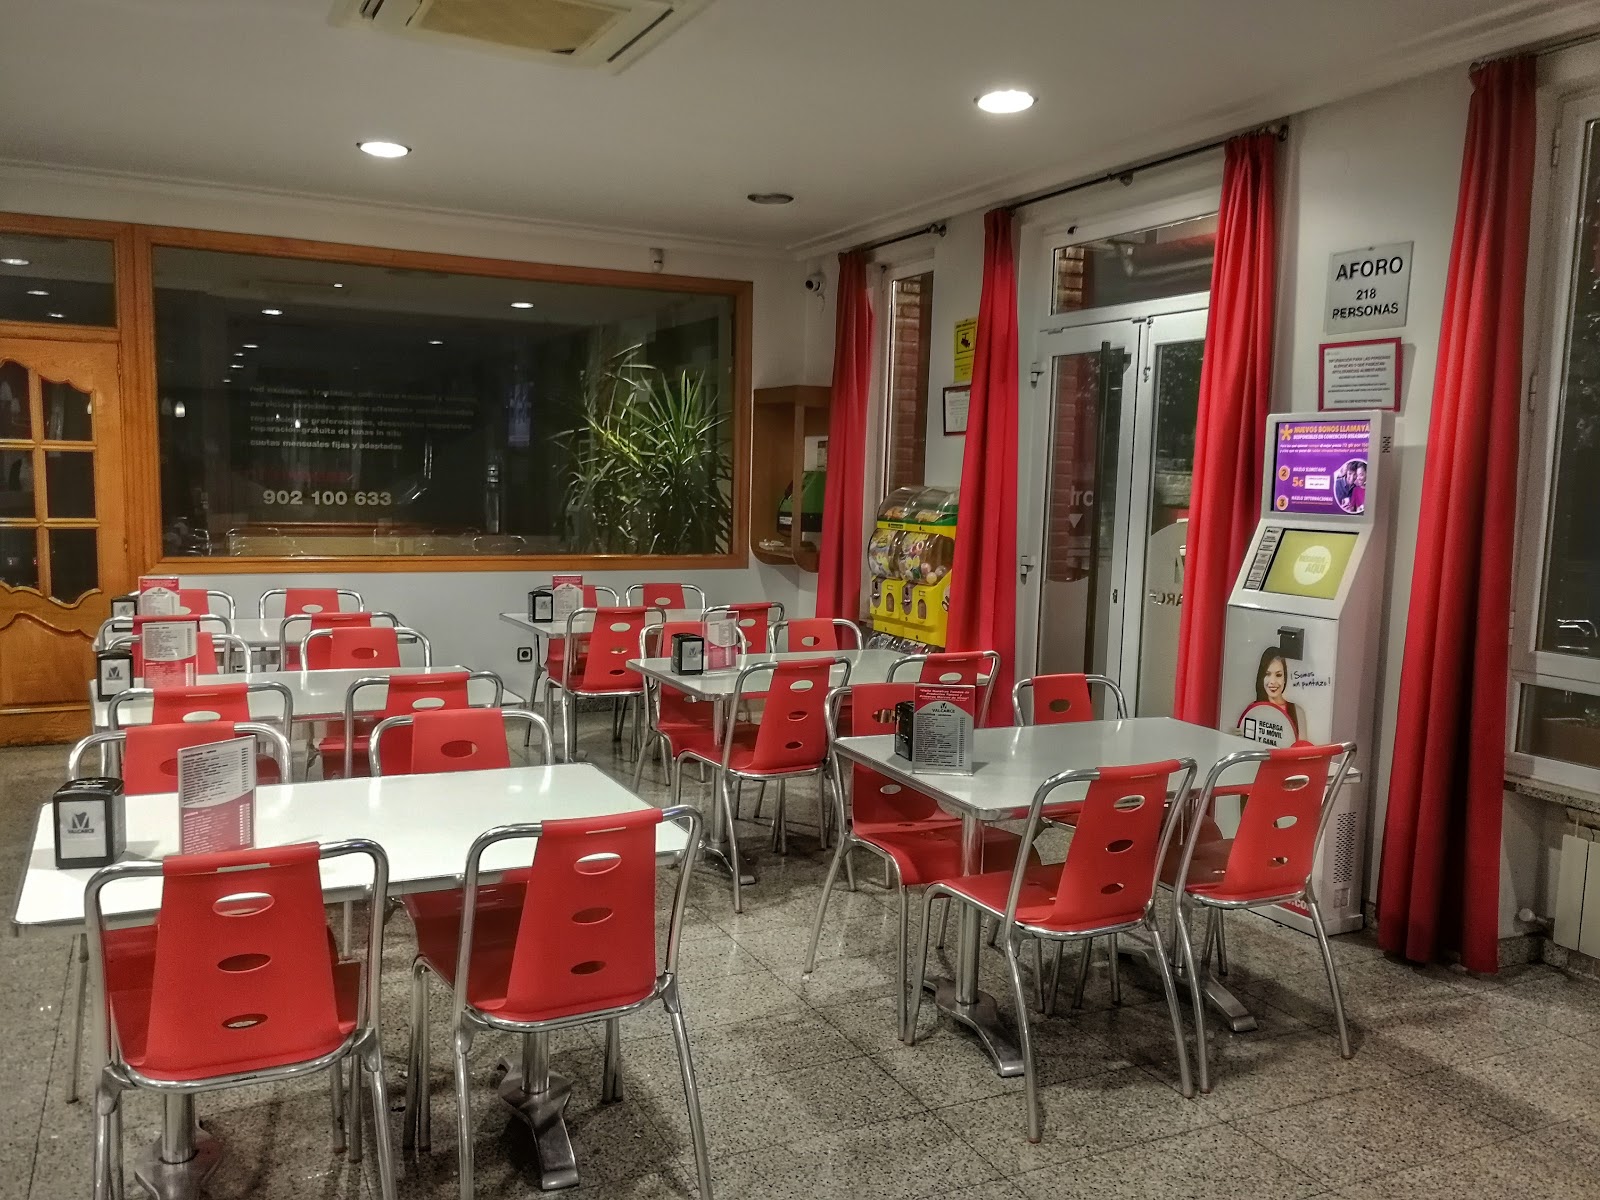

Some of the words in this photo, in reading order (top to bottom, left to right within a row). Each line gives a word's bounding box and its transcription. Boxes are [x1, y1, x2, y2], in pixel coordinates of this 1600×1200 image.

[1335, 256, 1404, 281] AFORO
[1356, 288, 1376, 301] 218
[1332, 302, 1399, 319] PERSONAS
[301, 427, 335, 435] gratuita
[282, 440, 329, 448] mensuales
[331, 441, 350, 449] fijas
[359, 442, 403, 450] adaptadas
[1281, 469, 1287, 477] 2
[263, 490, 303, 505] 902
[311, 490, 348, 505] 100
[354, 491, 392, 506] 633
[1279, 499, 1285, 507] 3
[1259, 720, 1283, 731] RECARGA
[1263, 737, 1277, 747] GANA
